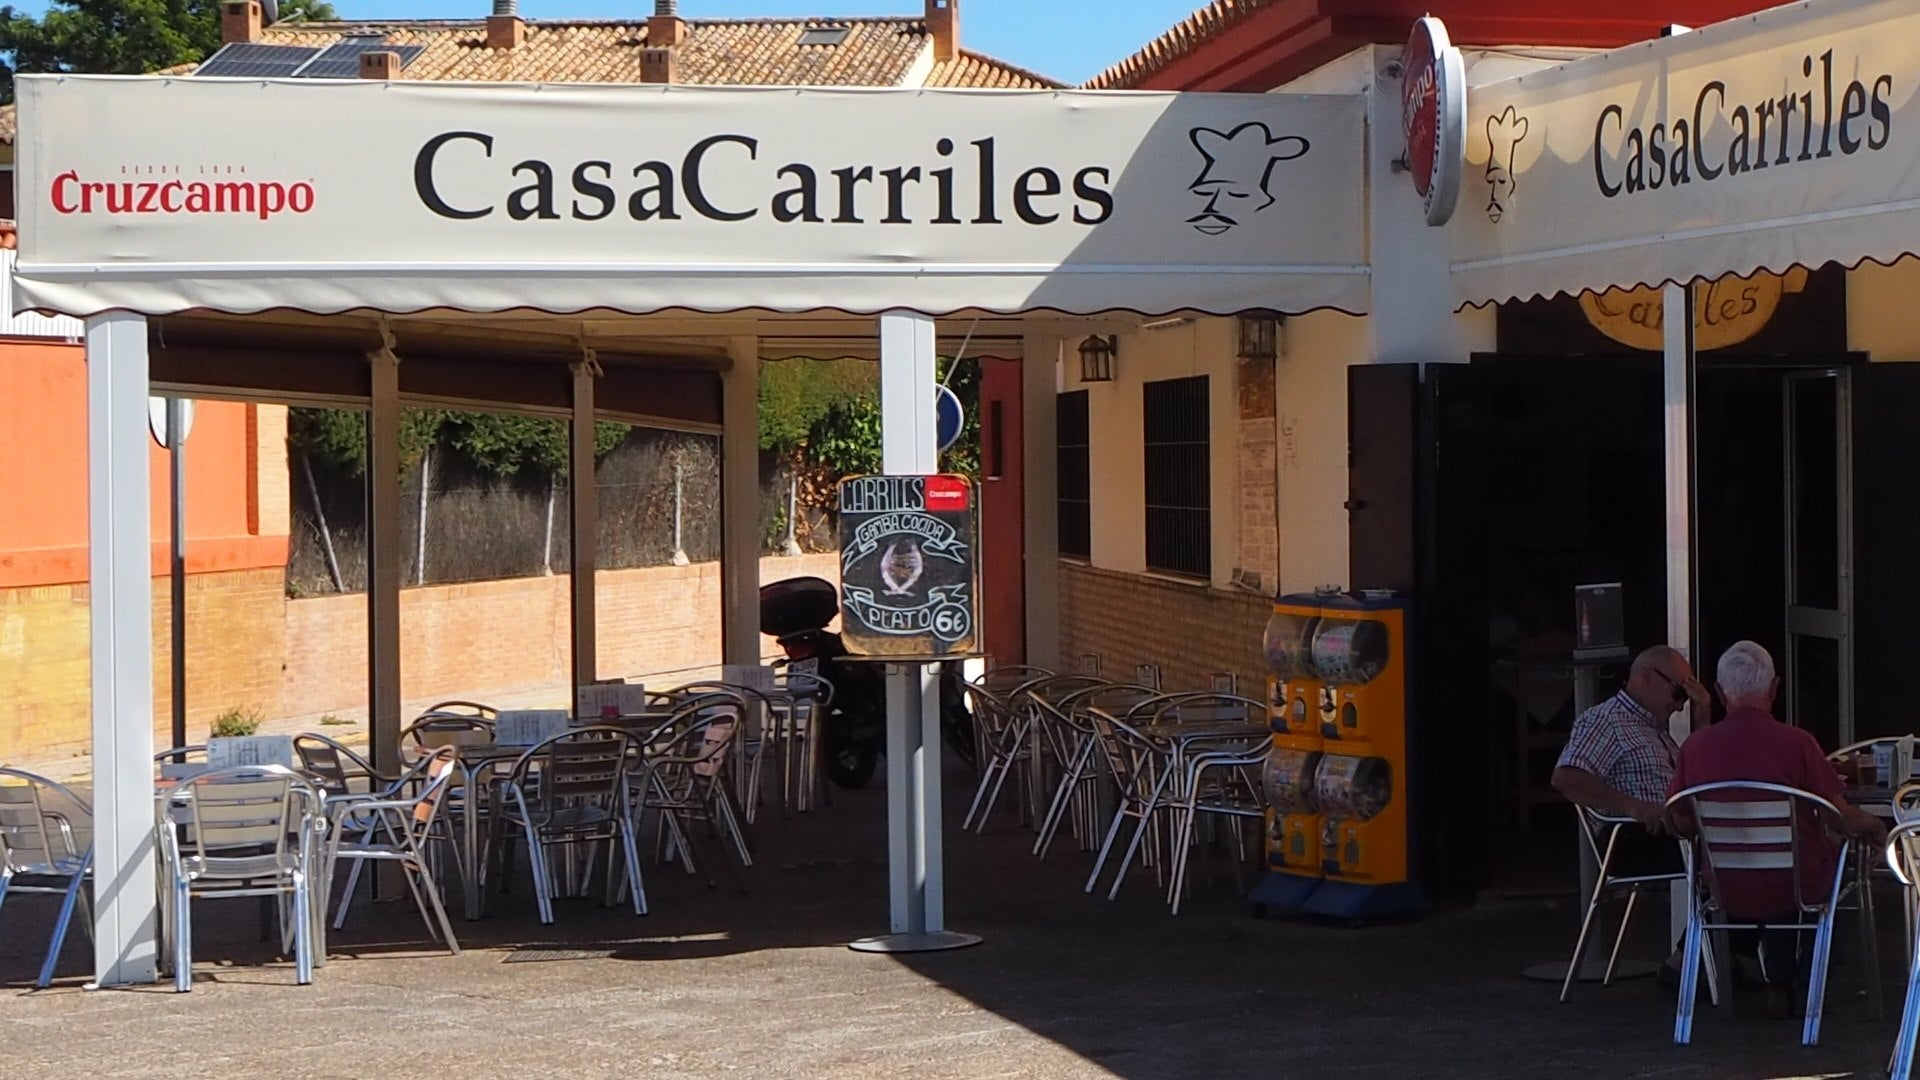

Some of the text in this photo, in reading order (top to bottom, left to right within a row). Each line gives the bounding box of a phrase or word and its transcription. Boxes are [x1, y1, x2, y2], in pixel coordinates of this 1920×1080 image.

[1594, 48, 1892, 198] CasaCarriles
[51, 169, 315, 220] Cruzcampo
[413, 130, 1115, 224] CasaCarriles
[841, 477, 926, 512] CARRILES
[860, 514, 945, 542] GAMBA COCIDA
[868, 607, 931, 629] PLATO
